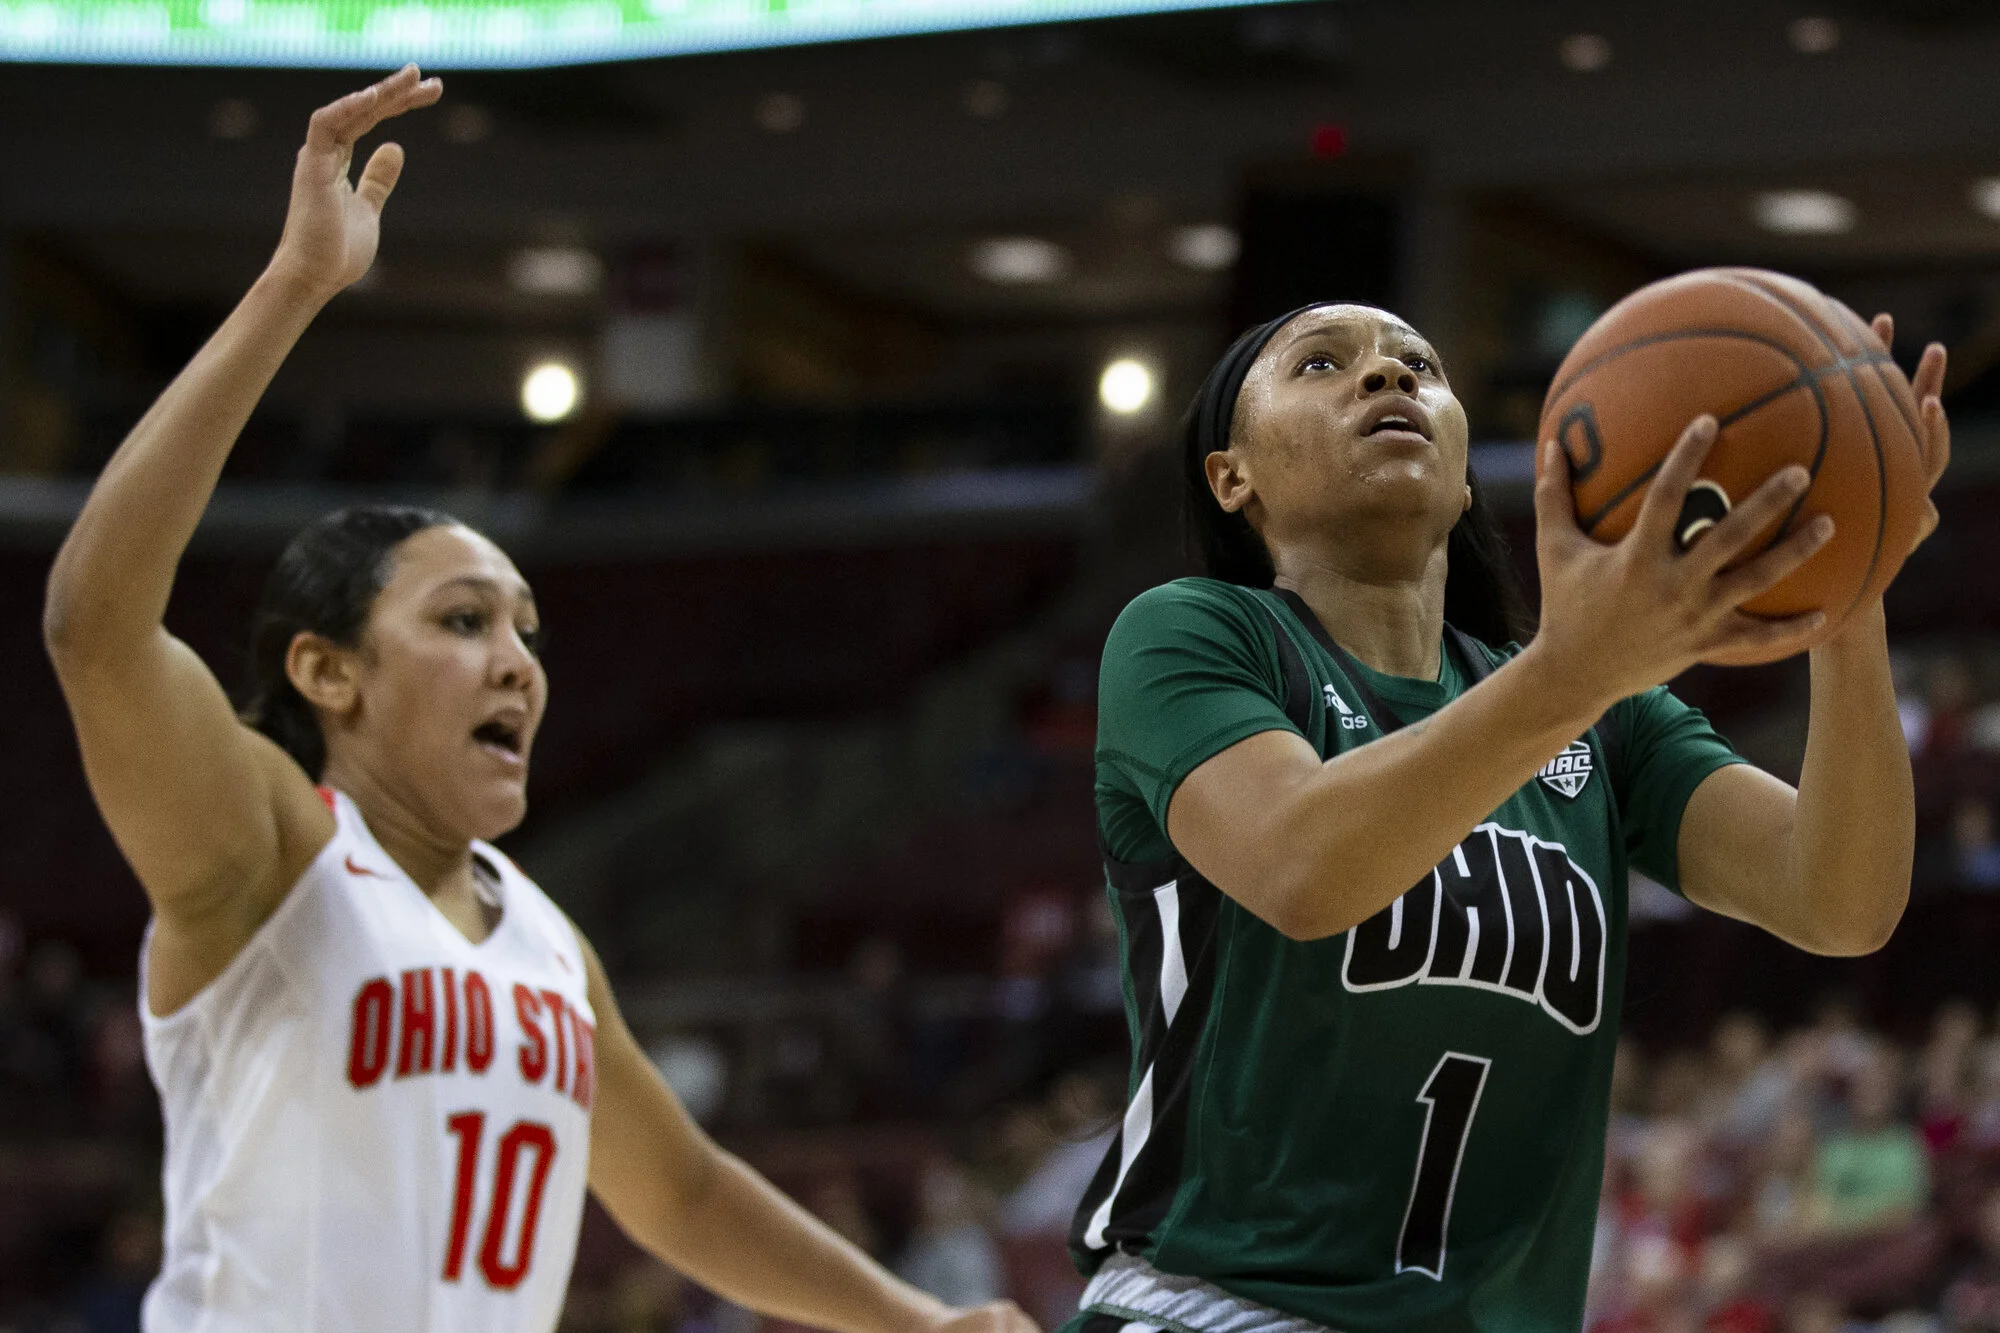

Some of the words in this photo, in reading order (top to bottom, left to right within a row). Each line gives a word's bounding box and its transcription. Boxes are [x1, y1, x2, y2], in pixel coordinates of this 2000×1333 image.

[1341, 822, 1606, 1036] OHIO
[347, 967, 496, 1090] OHIO
[441, 1109, 558, 1292] 10
[1395, 1051, 1492, 1281] 1
